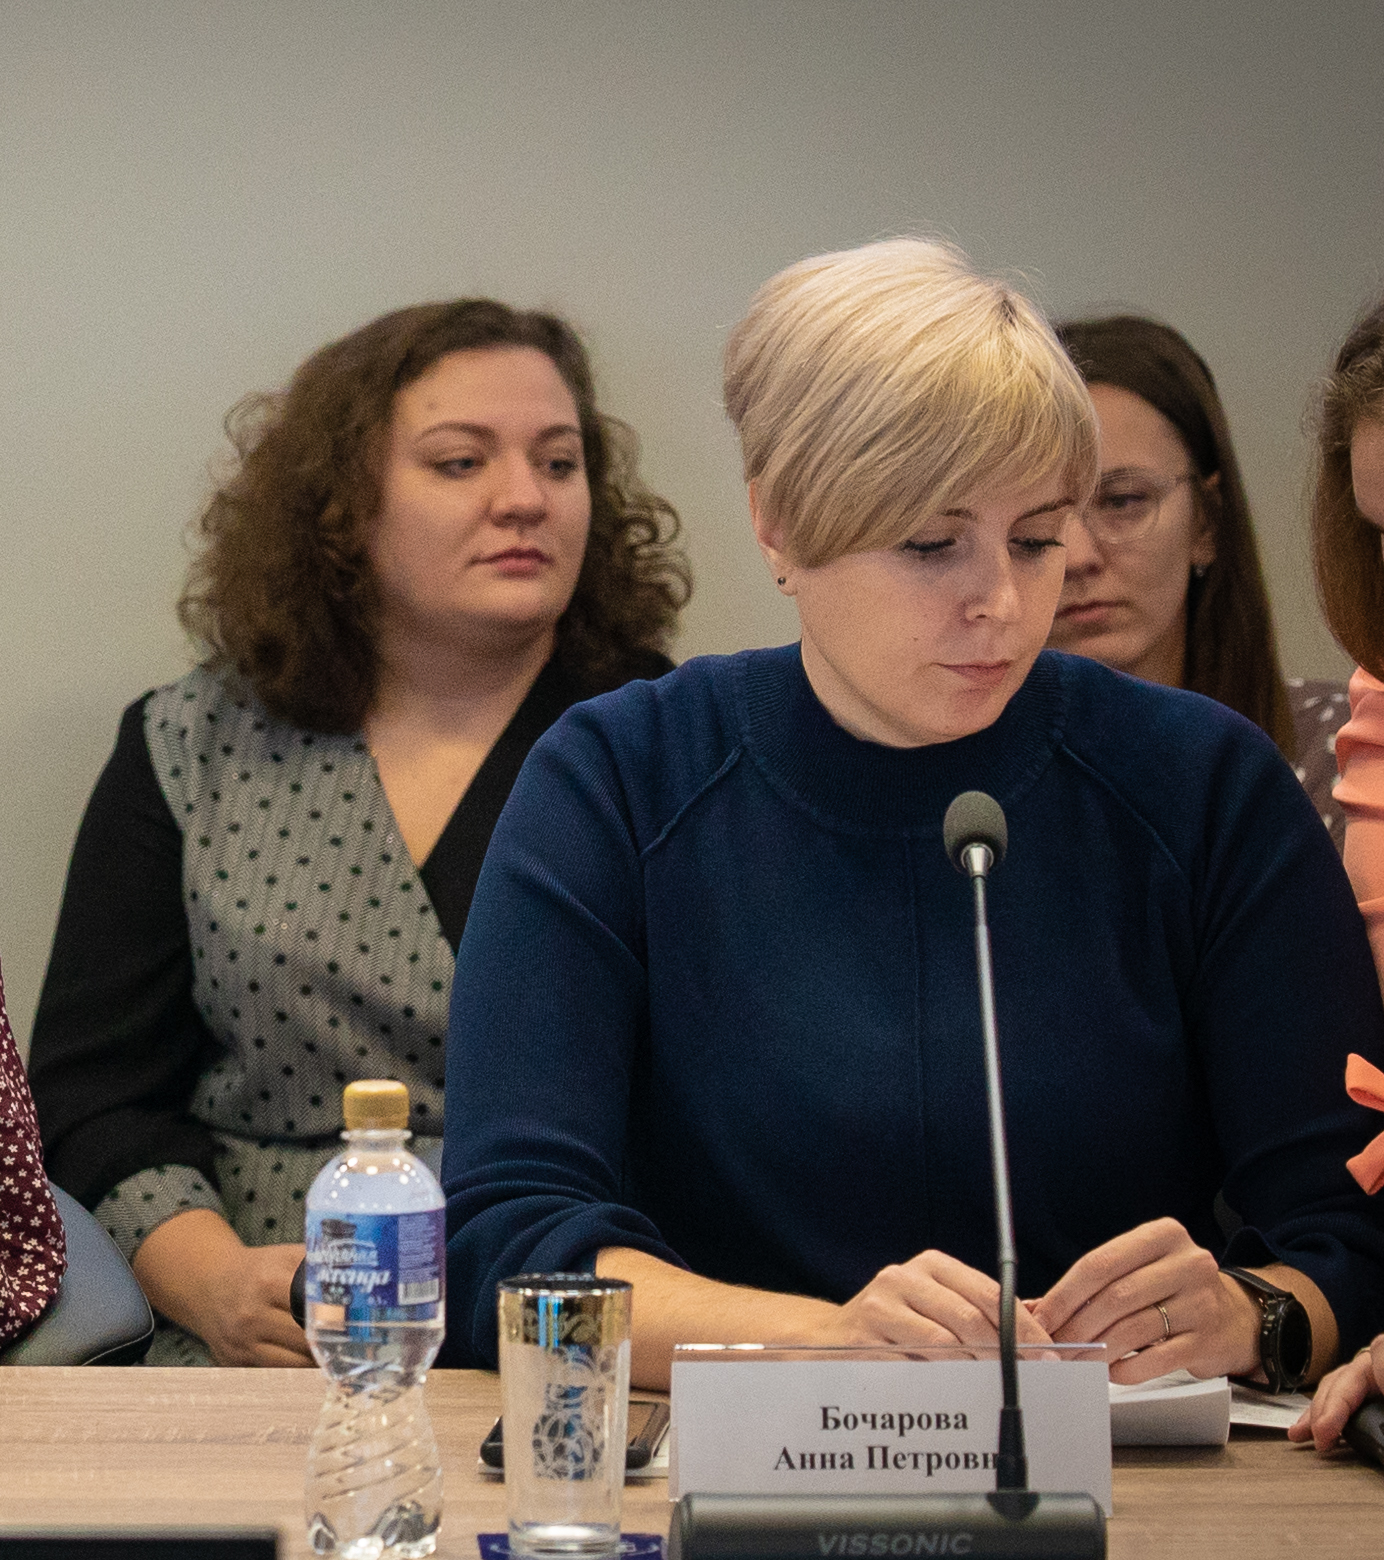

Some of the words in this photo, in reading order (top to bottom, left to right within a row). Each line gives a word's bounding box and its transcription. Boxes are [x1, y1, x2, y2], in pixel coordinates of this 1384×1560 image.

[819, 1405, 969, 1438] Бочарова
[773, 1446, 856, 1471] Анна
[866, 1445, 1000, 1478] Петровн
[818, 1532, 974, 1556] VISSONIC
